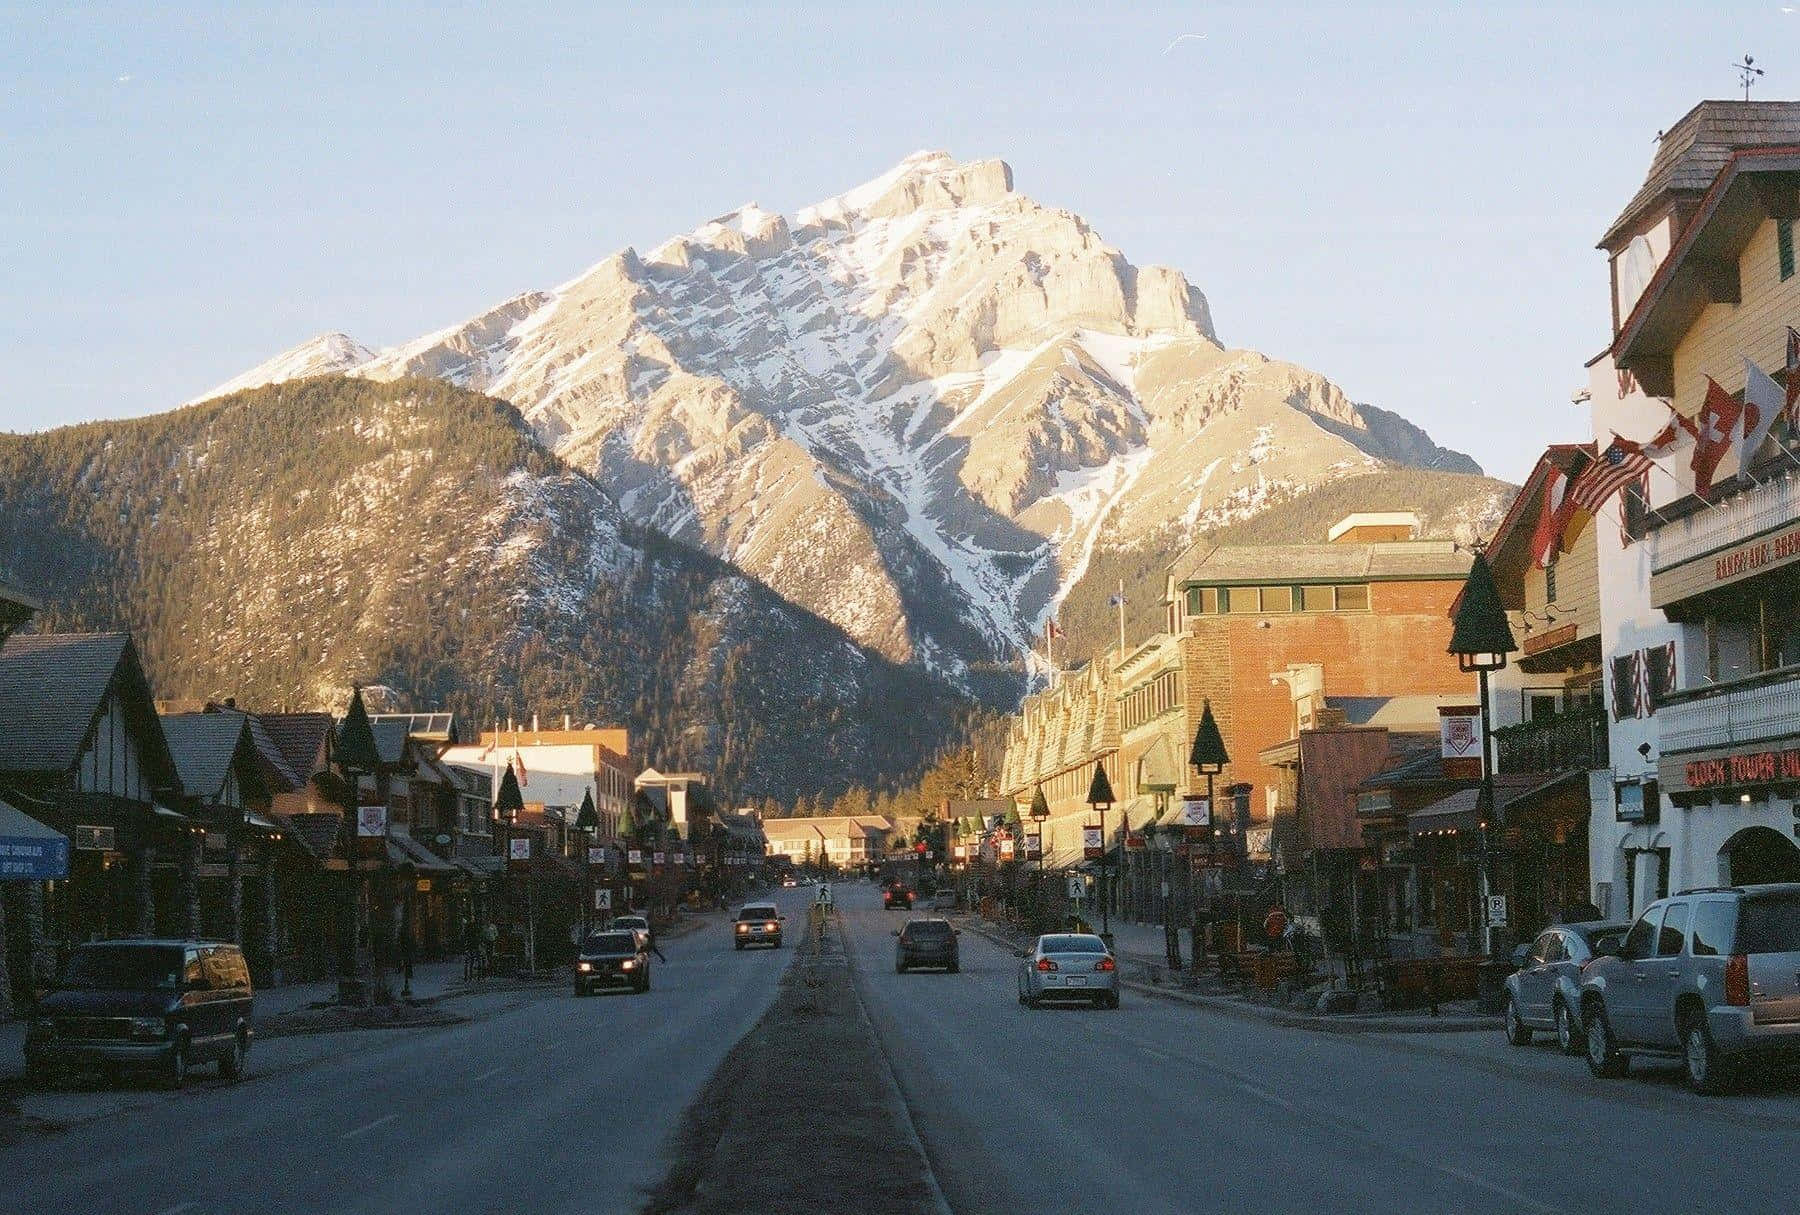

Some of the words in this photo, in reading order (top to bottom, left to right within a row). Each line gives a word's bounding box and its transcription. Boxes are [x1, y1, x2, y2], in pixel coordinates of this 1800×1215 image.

[1715, 551, 1747, 580] BANFF
[1685, 759, 1726, 788] CLOCK
[1730, 752, 1776, 783] TOWER
